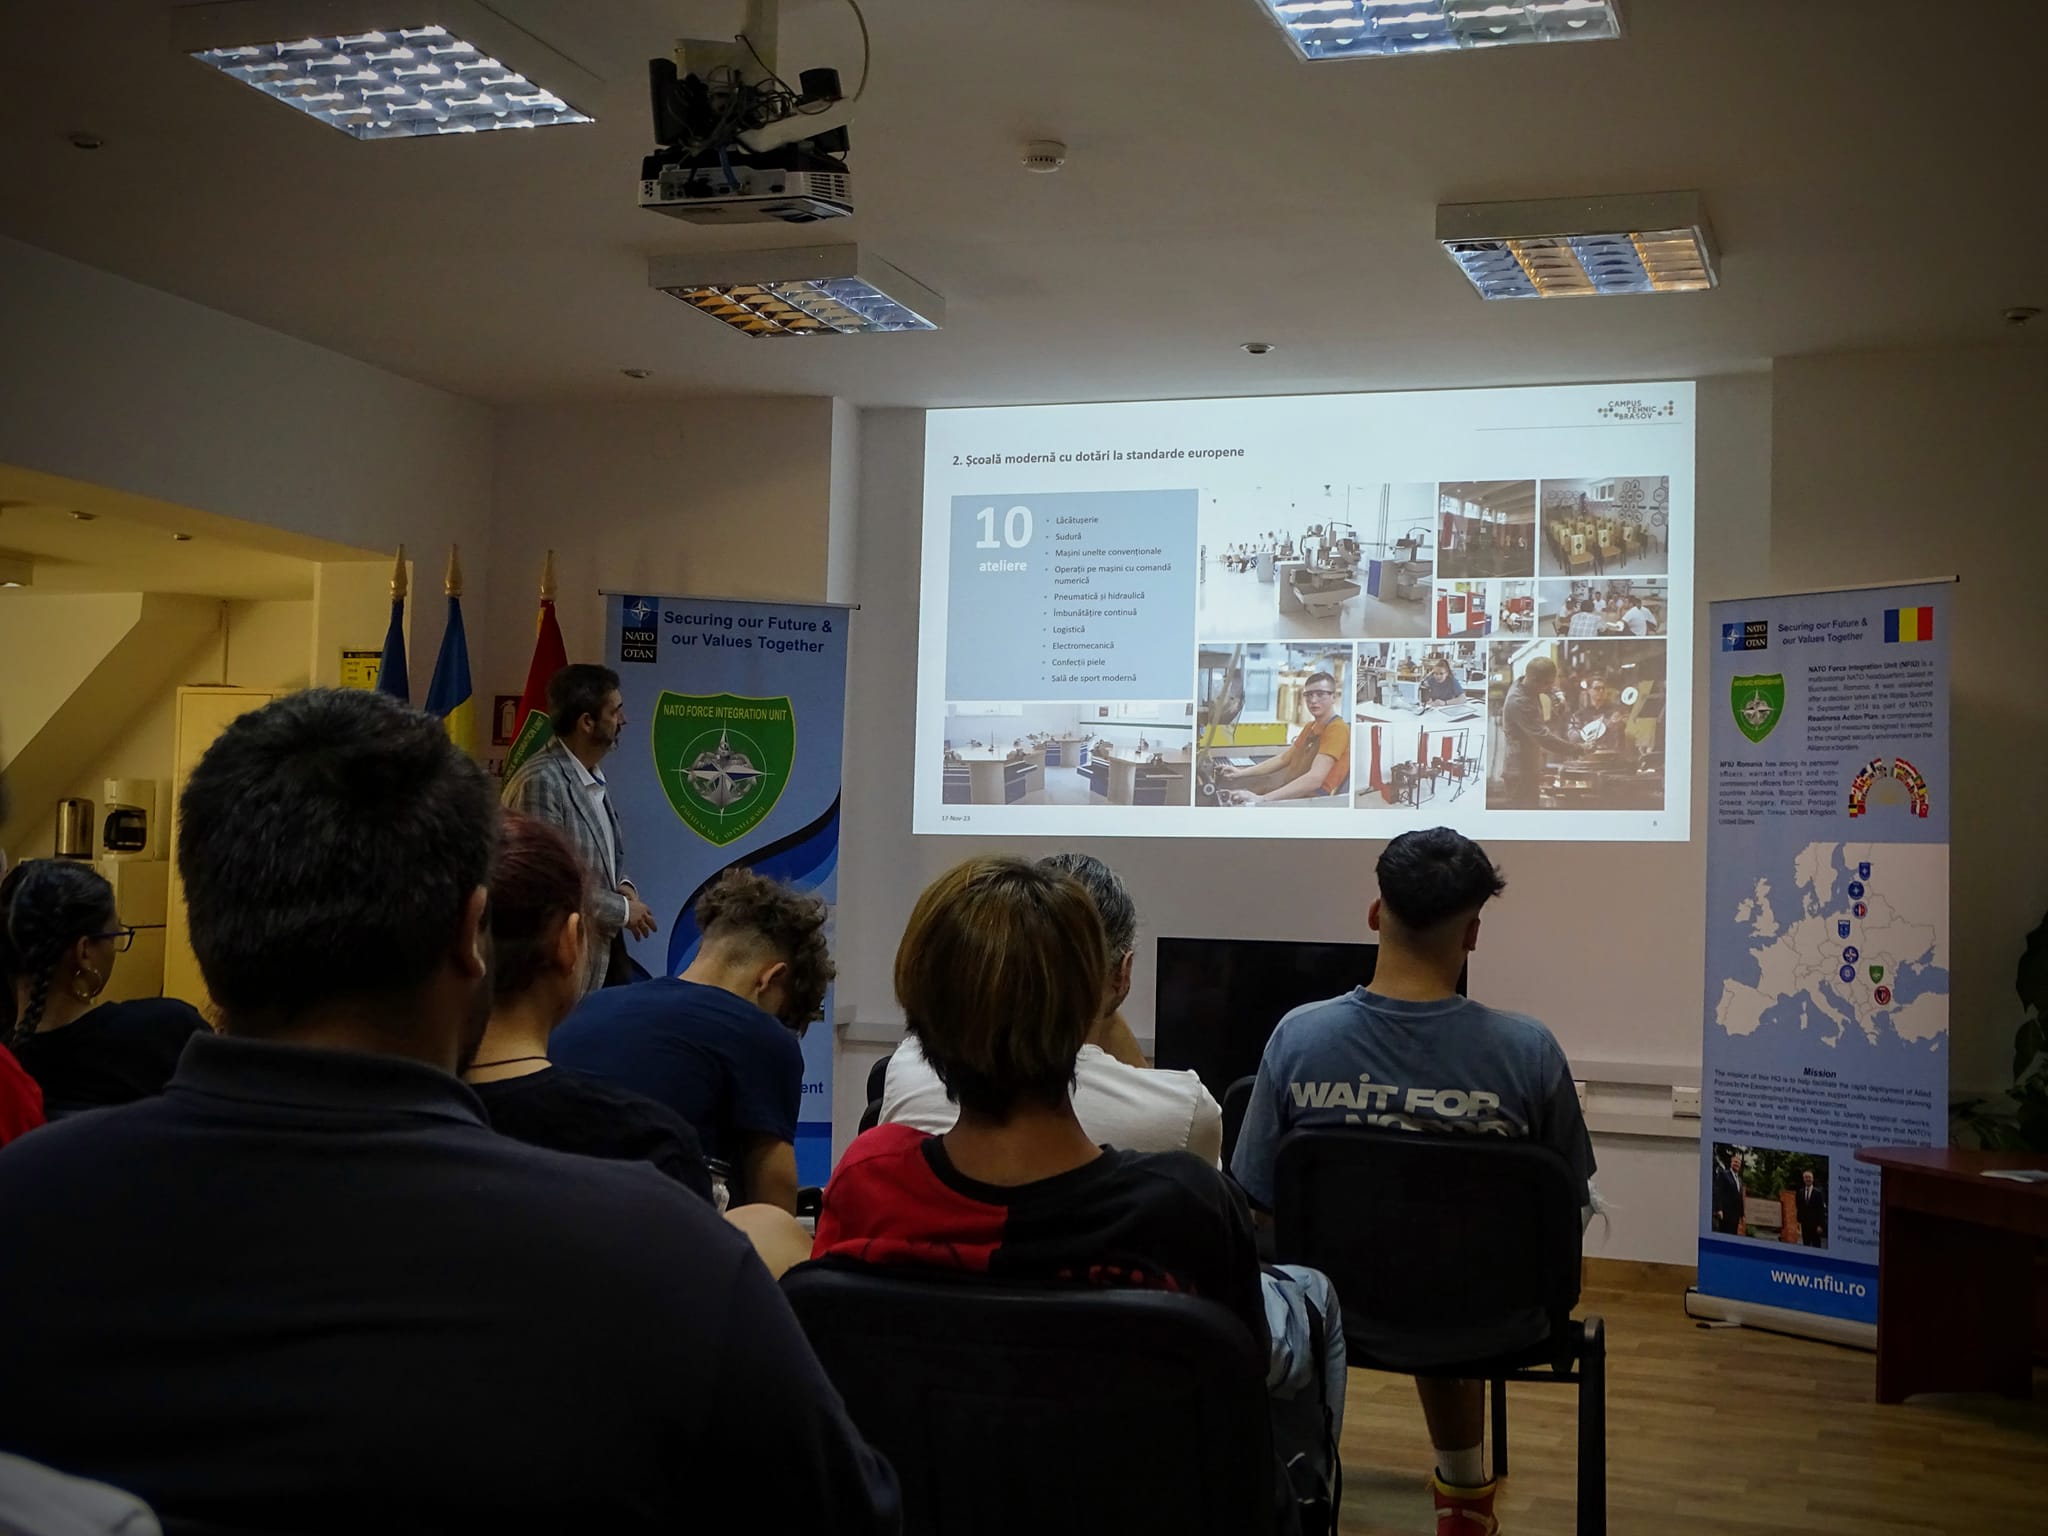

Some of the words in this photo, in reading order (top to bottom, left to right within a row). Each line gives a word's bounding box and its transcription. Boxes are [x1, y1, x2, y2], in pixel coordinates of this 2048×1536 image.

[953, 455, 963, 466] 2.
[966, 453, 1002, 467] Școală
[1005, 452, 1056, 464] modernă
[1059, 453, 1072, 462] cu
[1075, 450, 1110, 462] dotări
[1113, 450, 1123, 460] la
[1126, 448, 1185, 460] standarde
[1188, 448, 1245, 459] europene
[976, 505, 1033, 549] 10
[1055, 532, 1082, 541] Sudură
[1082, 548, 1106, 556] unelte
[979, 560, 1028, 572] ateliere
[1086, 566, 1096, 574] pe
[1054, 592, 1098, 601] Pneumatică
[1108, 591, 1145, 600] hidraulică
[664, 611, 733, 629] Securing
[738, 617, 764, 629] our
[768, 616, 817, 632] Future
[821, 620, 833, 633] &
[1778, 621, 1814, 634] Securing
[1816, 622, 1831, 631] our
[1832, 618, 1859, 630] Future
[1861, 617, 1868, 627] &
[1053, 625, 1086, 634] Logistică
[1746, 623, 1766, 633] NATO
[625, 631, 655, 642] NATO
[1782, 636, 1796, 646] our
[1798, 633, 1825, 645] Values
[1828, 631, 1863, 644] Together
[671, 634, 698, 646] our
[702, 633, 753, 648] Values
[758, 636, 825, 653] Together
[1052, 641, 1115, 650] Electromecanică
[1745, 638, 1766, 648] OTAN
[624, 648, 654, 659] OTAN
[1087, 658, 1106, 667] piele
[1808, 665, 1827, 673] NATO
[1848, 662, 1882, 673] Integration
[1051, 674, 1067, 683] Sală
[1069, 674, 1079, 682] de
[1080, 675, 1101, 684] sport
[1102, 673, 1137, 682] modernă
[663, 704, 685, 717] NATO
[687, 705, 716, 718] FORCE
[715, 706, 768, 720] INTEGRATION
[769, 709, 787, 721] UNIT
[1803, 1067, 1837, 1079] Mission
[800, 1081, 823, 1094] ent
[1403, 1087, 1501, 1117] FOR
[1771, 1268, 1866, 1298] www.nfiu.ro
